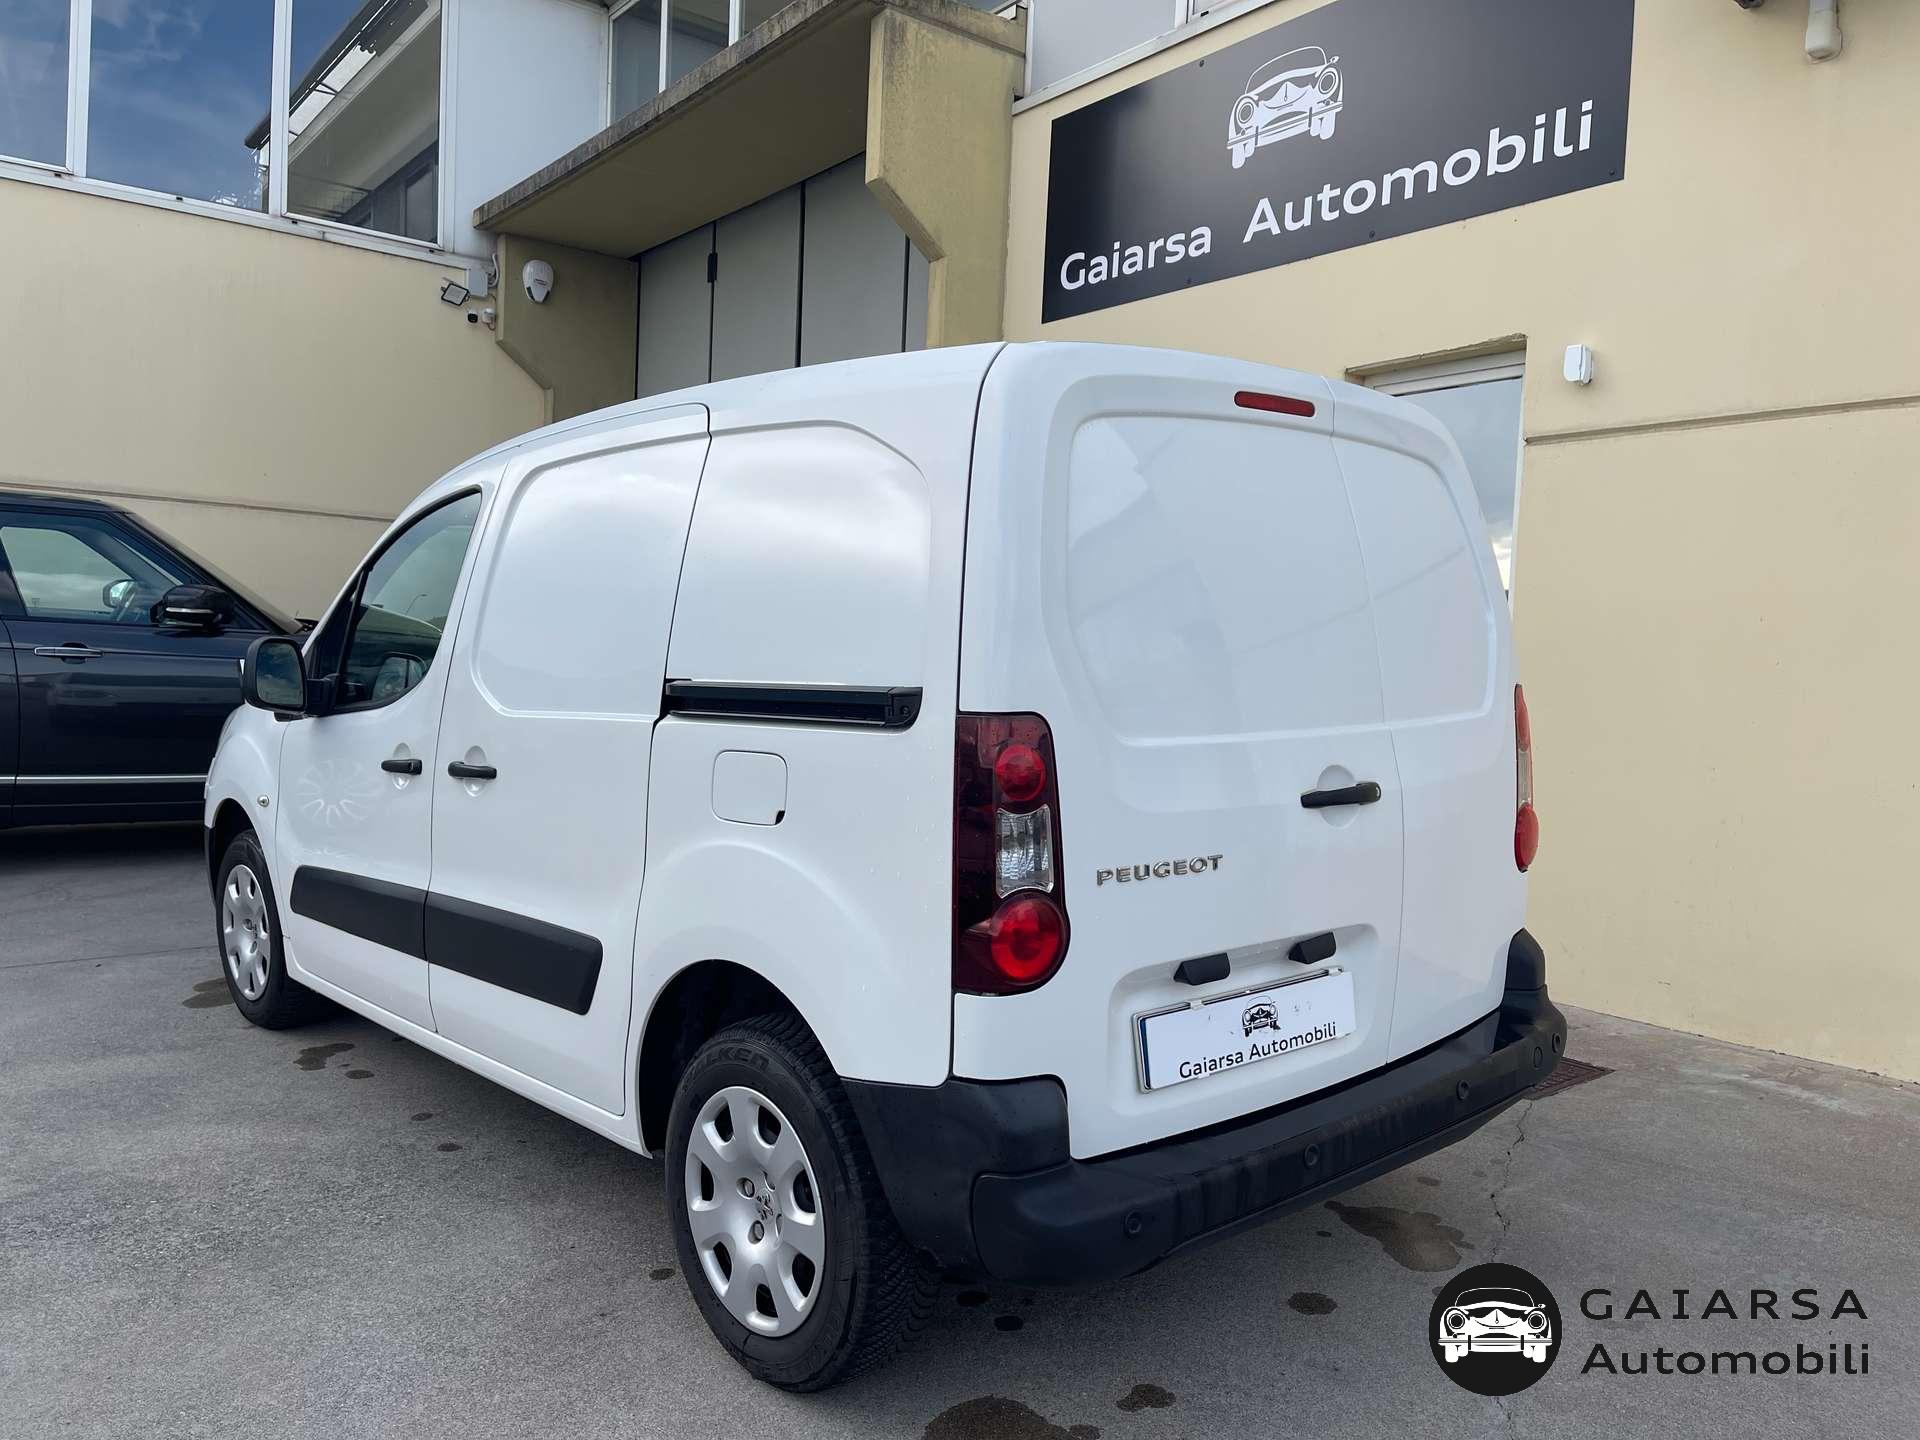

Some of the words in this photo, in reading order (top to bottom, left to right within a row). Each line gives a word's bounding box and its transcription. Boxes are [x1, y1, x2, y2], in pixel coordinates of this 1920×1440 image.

[1060, 226, 1212, 290] Gaiarsa
[1242, 99, 1593, 244] Automobili
[1096, 854, 1224, 887] PEUGEOT
[1179, 1052, 1244, 1079] Gaiarsa
[1249, 1022, 1337, 1060] Automobili
